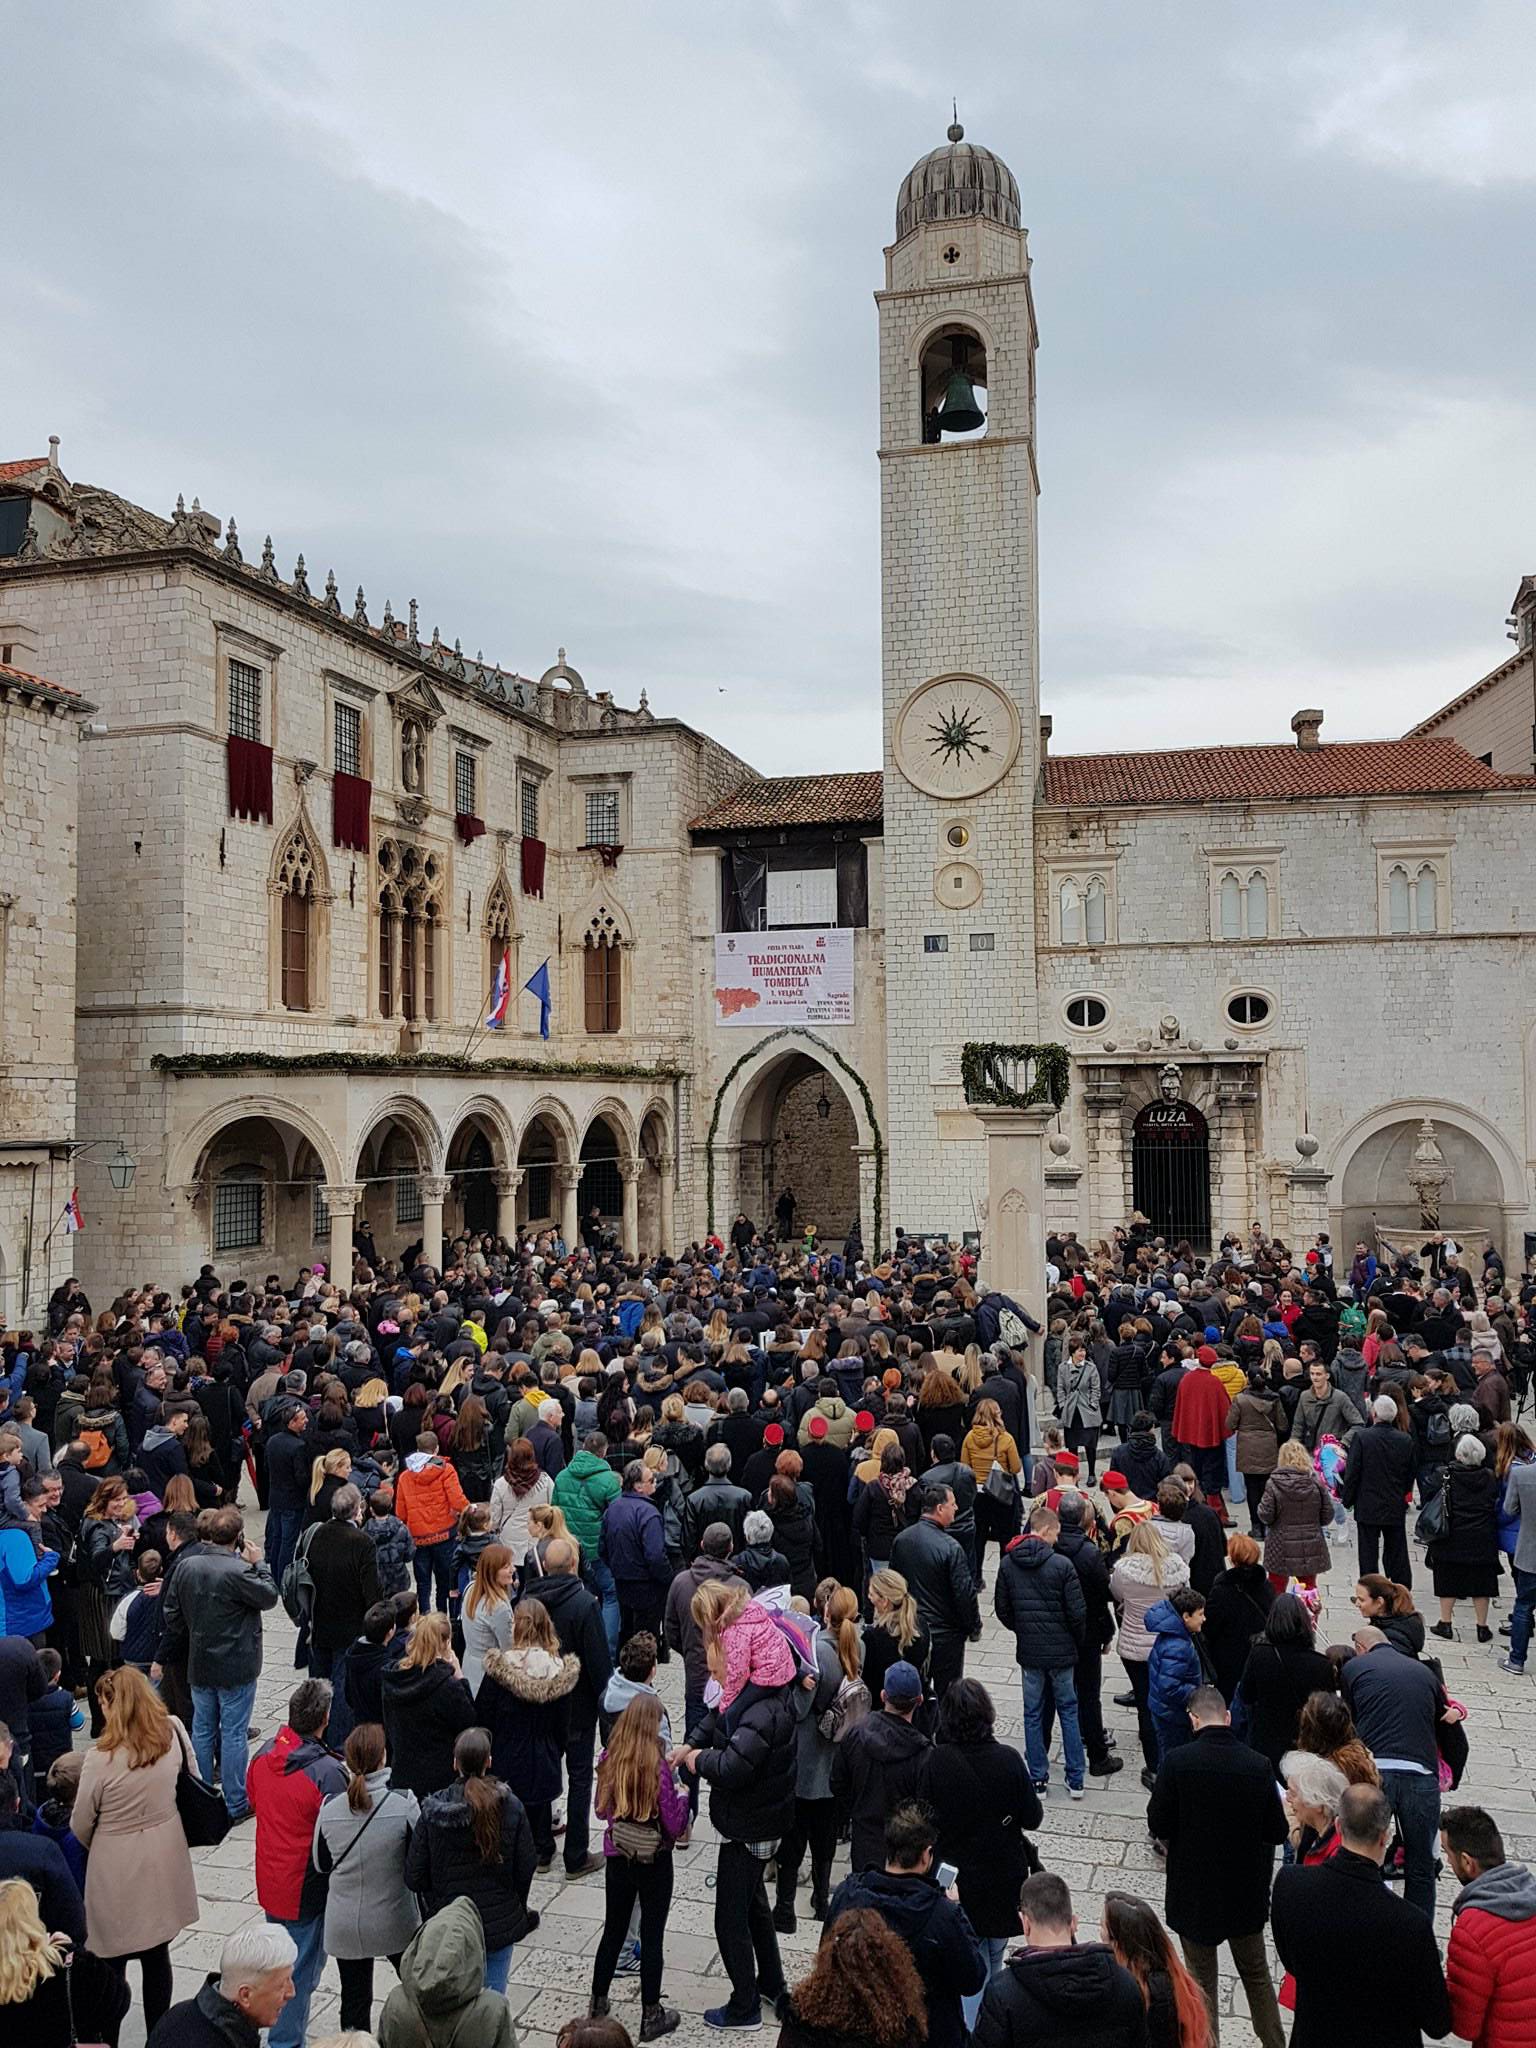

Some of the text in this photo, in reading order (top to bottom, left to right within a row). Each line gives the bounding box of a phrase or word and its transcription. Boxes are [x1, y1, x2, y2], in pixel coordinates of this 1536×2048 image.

[747, 953, 825, 965] TRADICIONALNA
[752, 965, 822, 977] HUMANITARNA
[764, 977, 809, 987] TOMBULA
[1149, 1107, 1187, 1122] LUŽA
